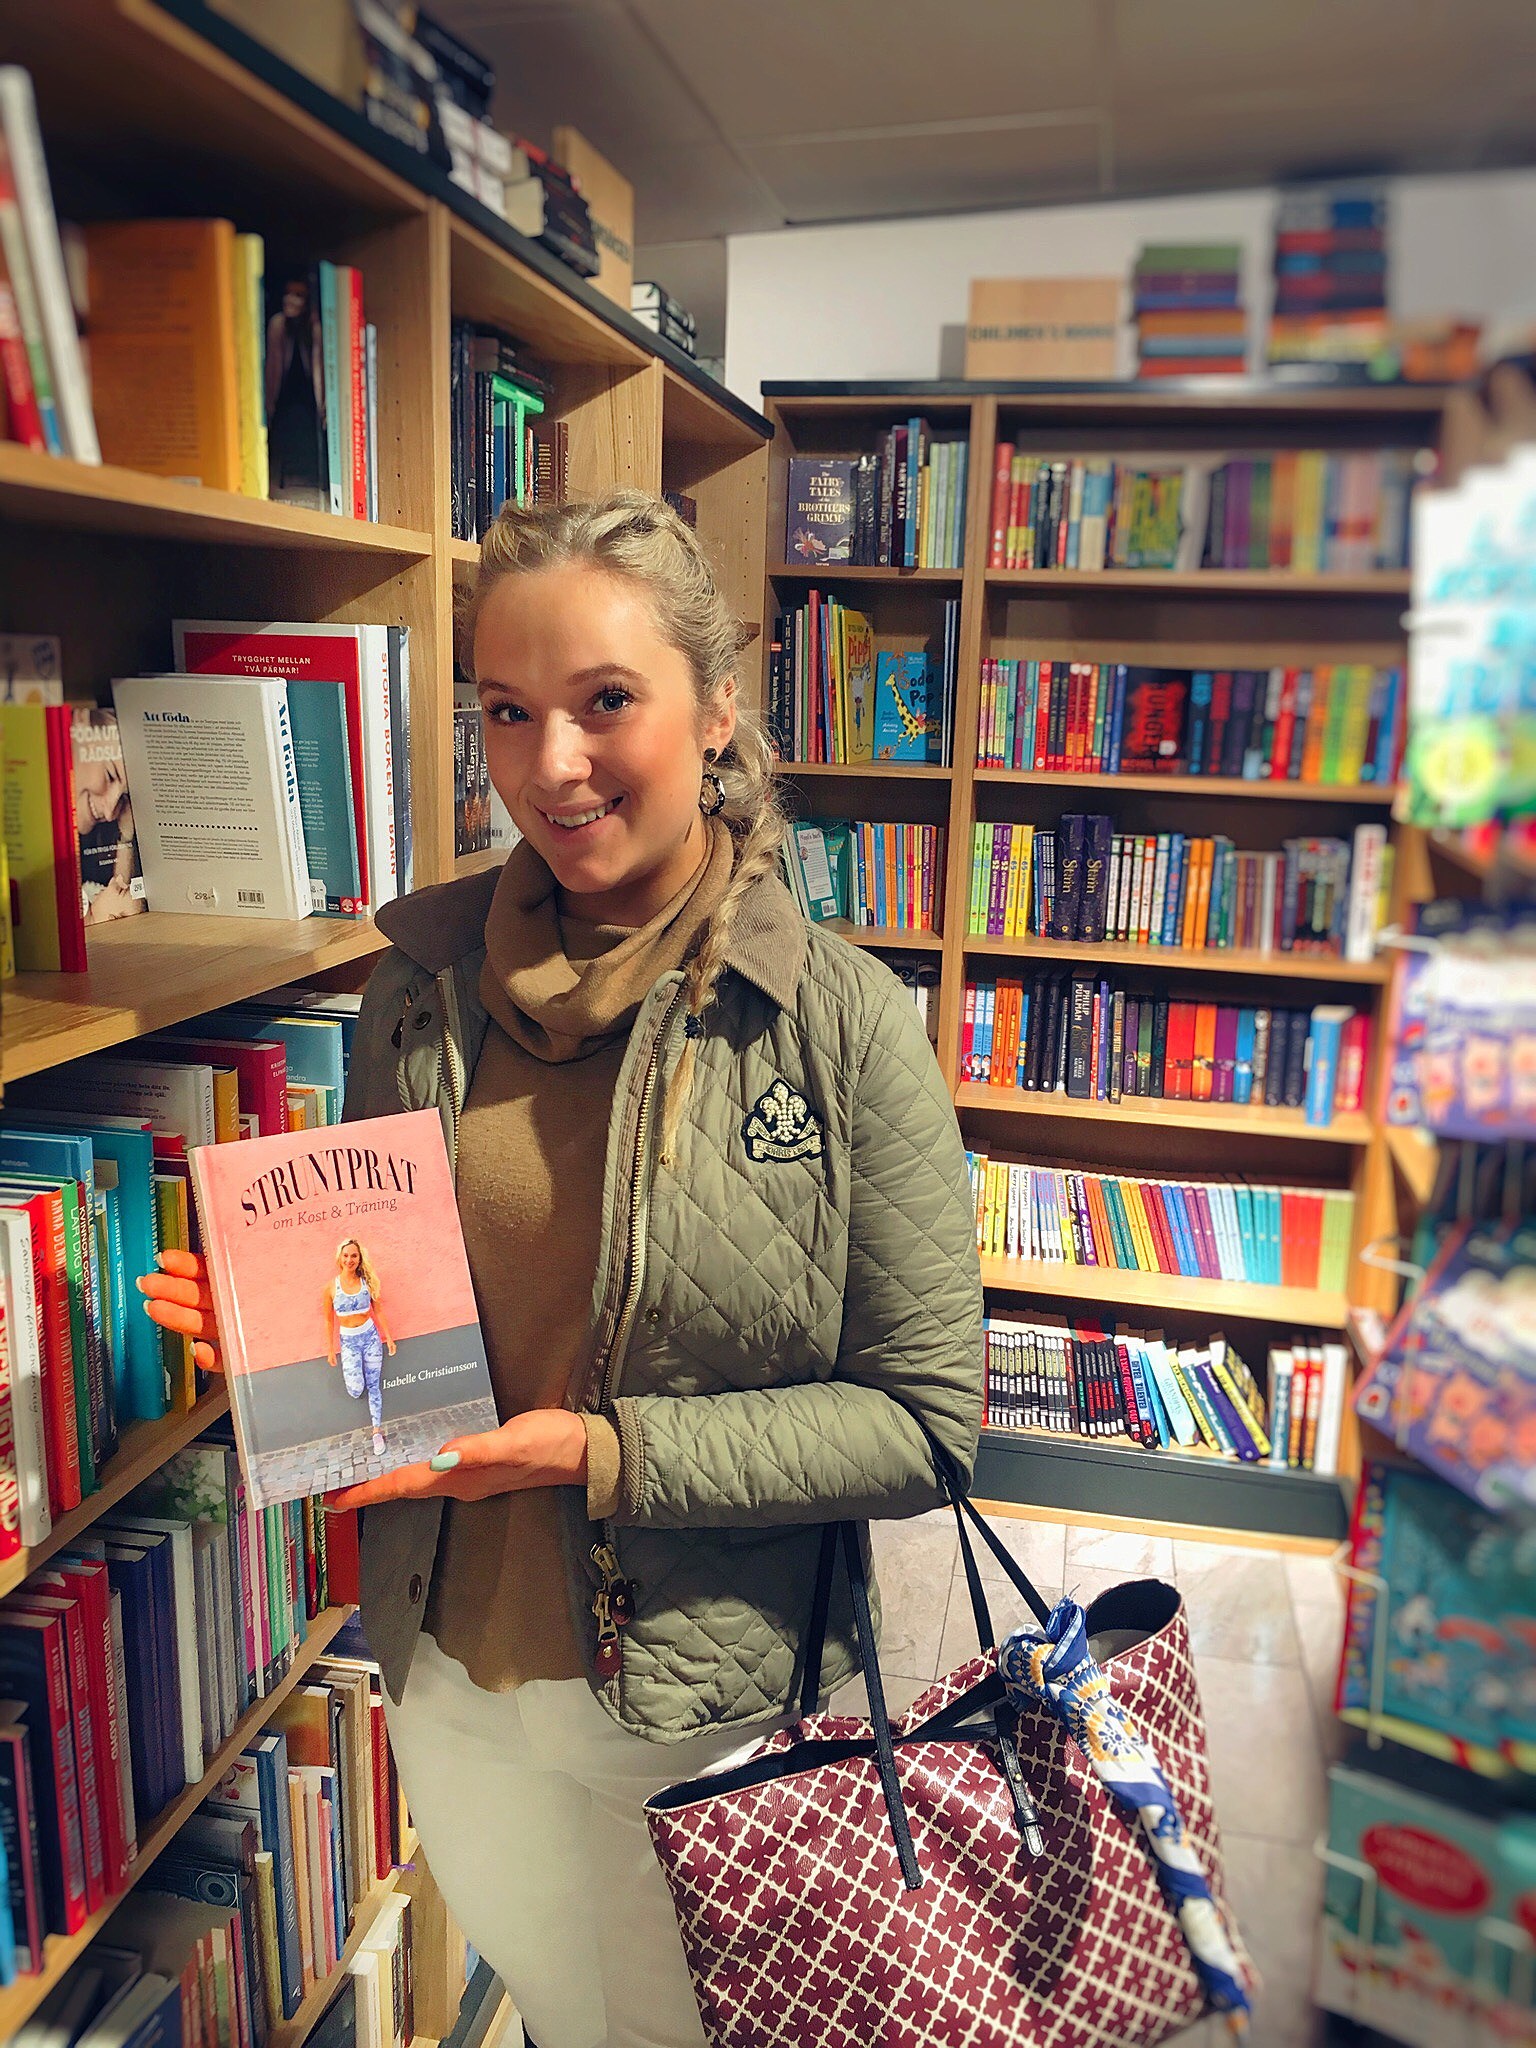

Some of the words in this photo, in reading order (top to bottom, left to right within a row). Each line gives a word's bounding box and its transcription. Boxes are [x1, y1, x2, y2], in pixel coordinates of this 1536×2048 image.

[809, 476, 843, 487] FAIRY
[898, 462, 906, 488] FAIRY
[808, 487, 841, 497] TALES
[897, 488, 905, 519] TALES
[797, 503, 850, 513] BROTHERS
[806, 513, 844, 524] GRIMM
[232, 655, 275, 665] TRYGGHET
[277, 656, 311, 665] MELLAN
[244, 664, 261, 673] TVÅ
[262, 664, 299, 674] PÄRMAR!
[381, 652, 390, 721] STORA
[909, 689, 935, 707] Pop
[143, 711, 159, 722] Att
[162, 711, 190, 723] föda
[384, 729, 394, 796] BOKEN
[388, 824, 397, 876] BARN
[1073, 984, 1082, 1021] PULLMAN
[1081, 990, 1090, 1015] PHILIP
[85, 1169, 93, 1184] PIA
[240, 1148, 417, 1227] STRUNTPRAT
[51, 1199, 64, 1230] ANNA
[86, 1185, 96, 1257] CALLESEN
[272, 1217, 294, 1230] om
[298, 1210, 327, 1226] Kost
[331, 1205, 342, 1218] &
[345, 1198, 398, 1216] Träning
[79, 1206, 90, 1259] KVINNOR
[53, 1233, 67, 1287] BENNICH
[73, 1241, 83, 1269] DIG
[82, 1260, 91, 1286] OCH
[90, 1265, 98, 1284] LEV
[75, 1271, 84, 1312] LEVA
[92, 1287, 100, 1320] MER
[58, 1301, 70, 1323] ATT
[60, 1325, 72, 1366] VINNA
[94, 1325, 102, 1361] TÄNK
[1118, 1345, 1127, 1358] THE
[383, 1374, 417, 1390] Isabelle
[418, 1360, 478, 1381] Christiansson
[1121, 1358, 1130, 1374] EXACT
[1123, 1376, 1135, 1401] OPPOSITE
[1128, 1401, 1135, 1409] OF
[1129, 1410, 1138, 1424] OKAY
[64, 1402, 79, 1469] ENSAMHETEN
[0, 1456, 20, 1532] SKILD
[101, 1616, 117, 1718] UNDERBARA
[109, 1719, 119, 1761] ADHD
[284, 1857, 295, 1932] ANATOMI
